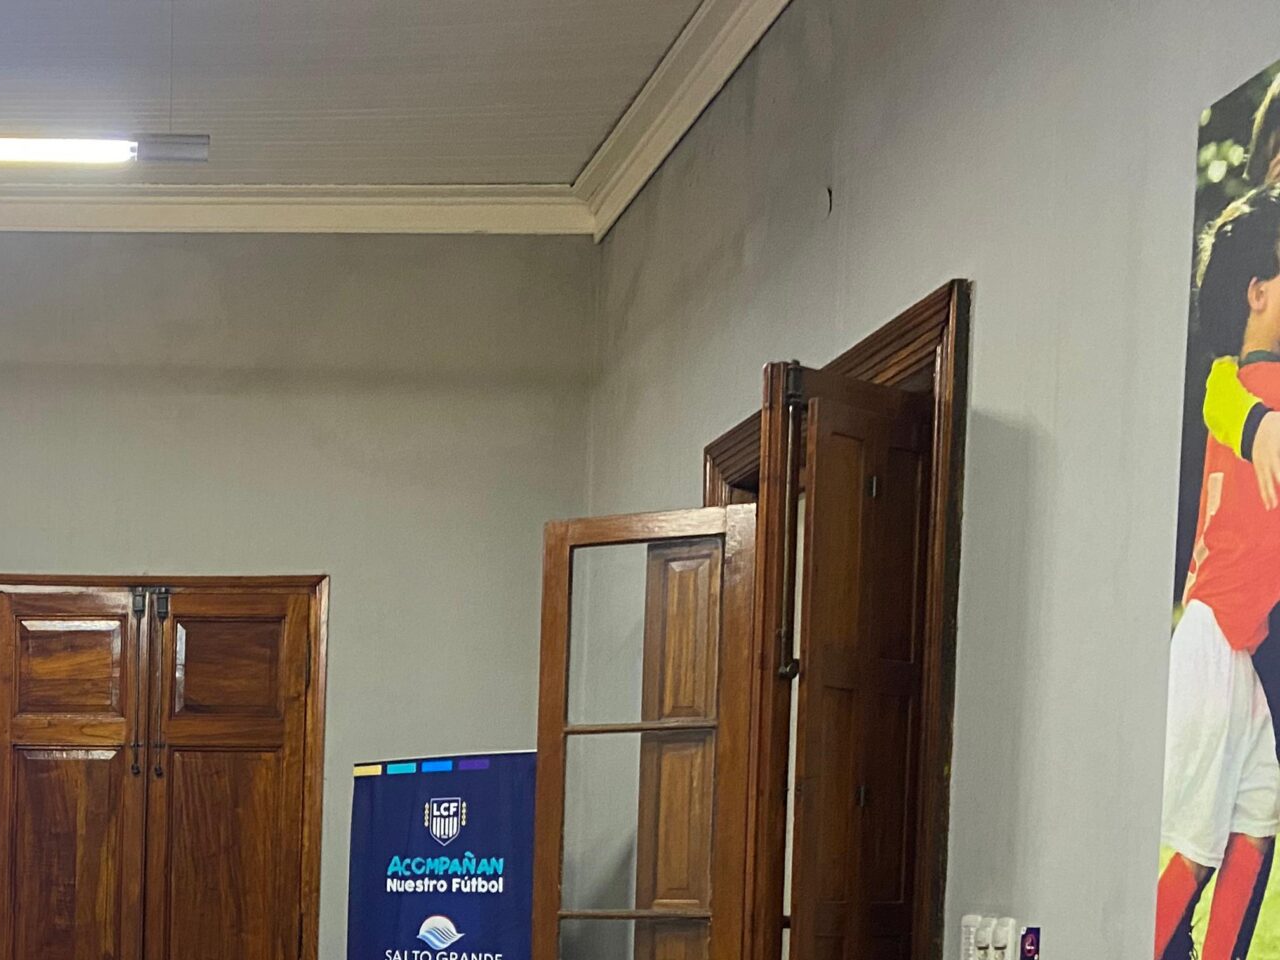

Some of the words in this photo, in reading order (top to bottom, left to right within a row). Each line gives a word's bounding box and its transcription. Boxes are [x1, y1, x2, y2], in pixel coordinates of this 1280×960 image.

[433, 802, 459, 816] LCF
[386, 877, 448, 893] Nuestro
[451, 876, 504, 893] Fútbol
